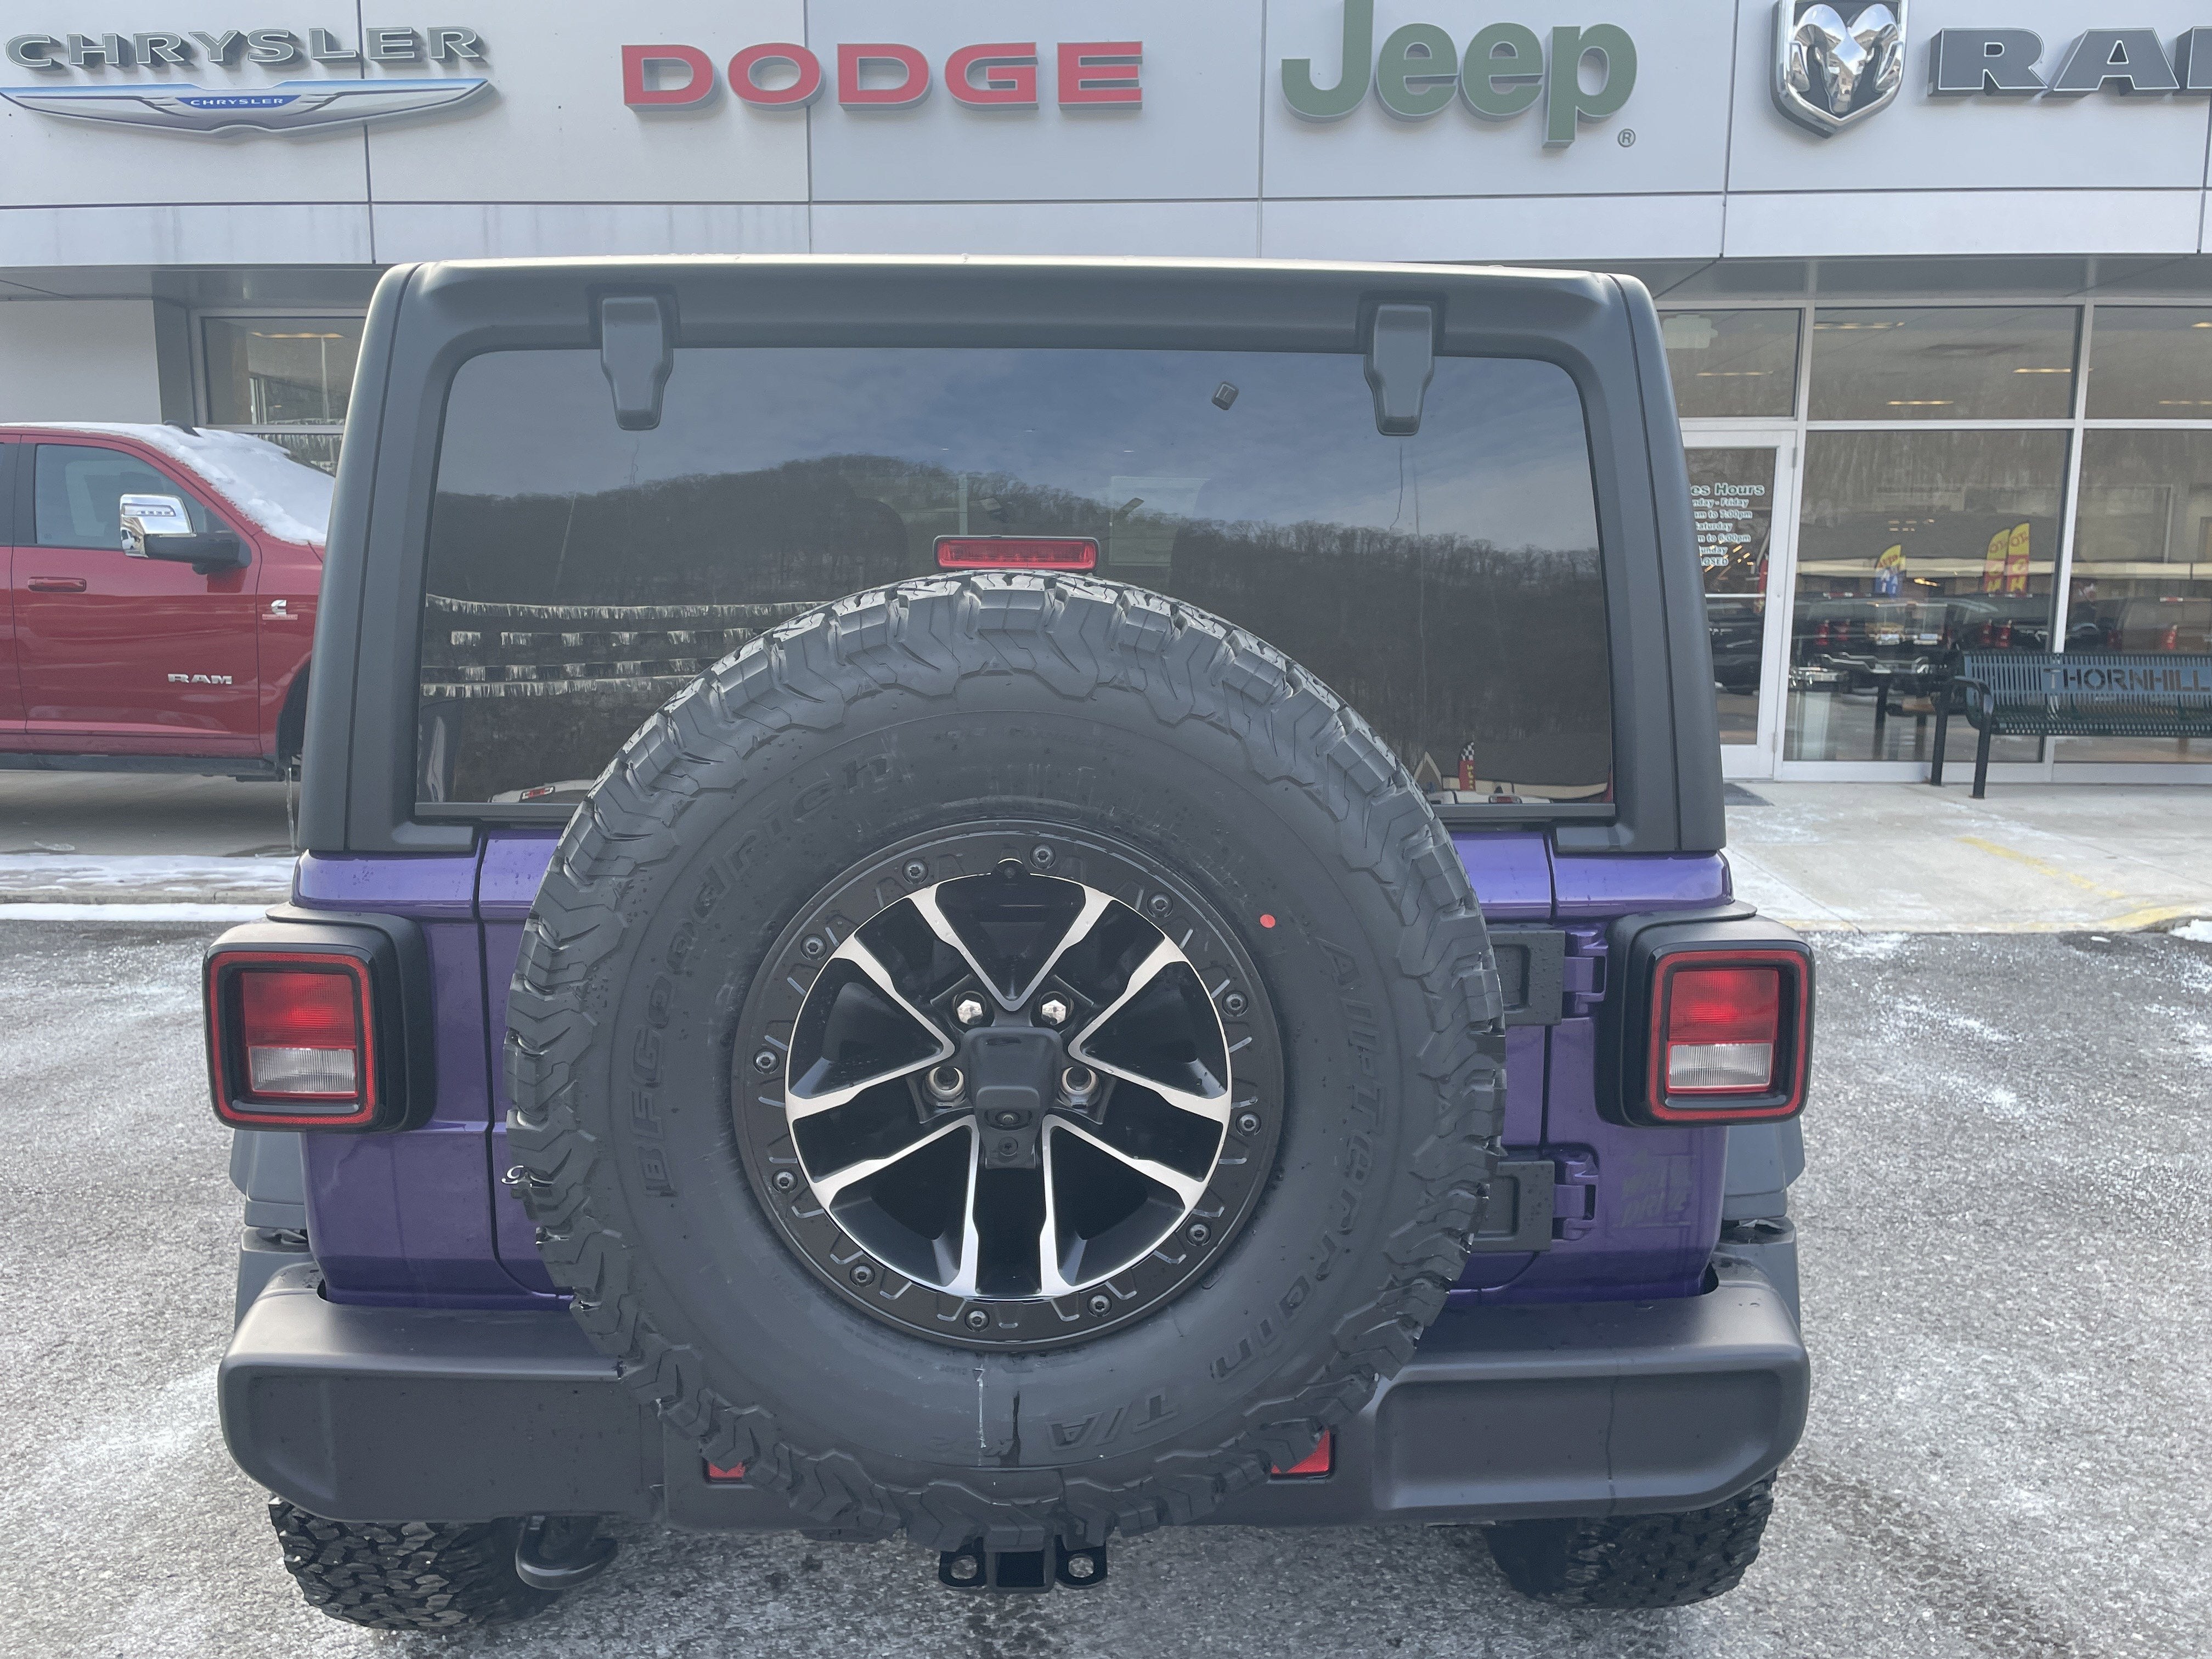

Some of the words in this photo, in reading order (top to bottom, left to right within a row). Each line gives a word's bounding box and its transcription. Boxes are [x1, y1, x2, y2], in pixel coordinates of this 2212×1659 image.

[4, 26, 486, 67] CHRYSLER
[1929, 26, 2212, 95] RA
[622, 41, 1143, 108] DODGE
[1281, 0, 1638, 148] Jeep
[190, 98, 284, 106] CHRYSLER
[1714, 482, 1765, 496] Hours
[1692, 498, 1714, 509] nday
[1720, 498, 1749, 509] Friday
[1708, 510, 1718, 519] to
[1706, 533, 1717, 543] to
[1699, 545, 1728, 556] unday
[1701, 556, 1729, 567] OSED
[167, 673, 232, 685] RAM
[2044, 668, 2210, 691] THORNHILL
[629, 746, 898, 1198] BFGoodrich
[1047, 1392, 1181, 1452] T/A
